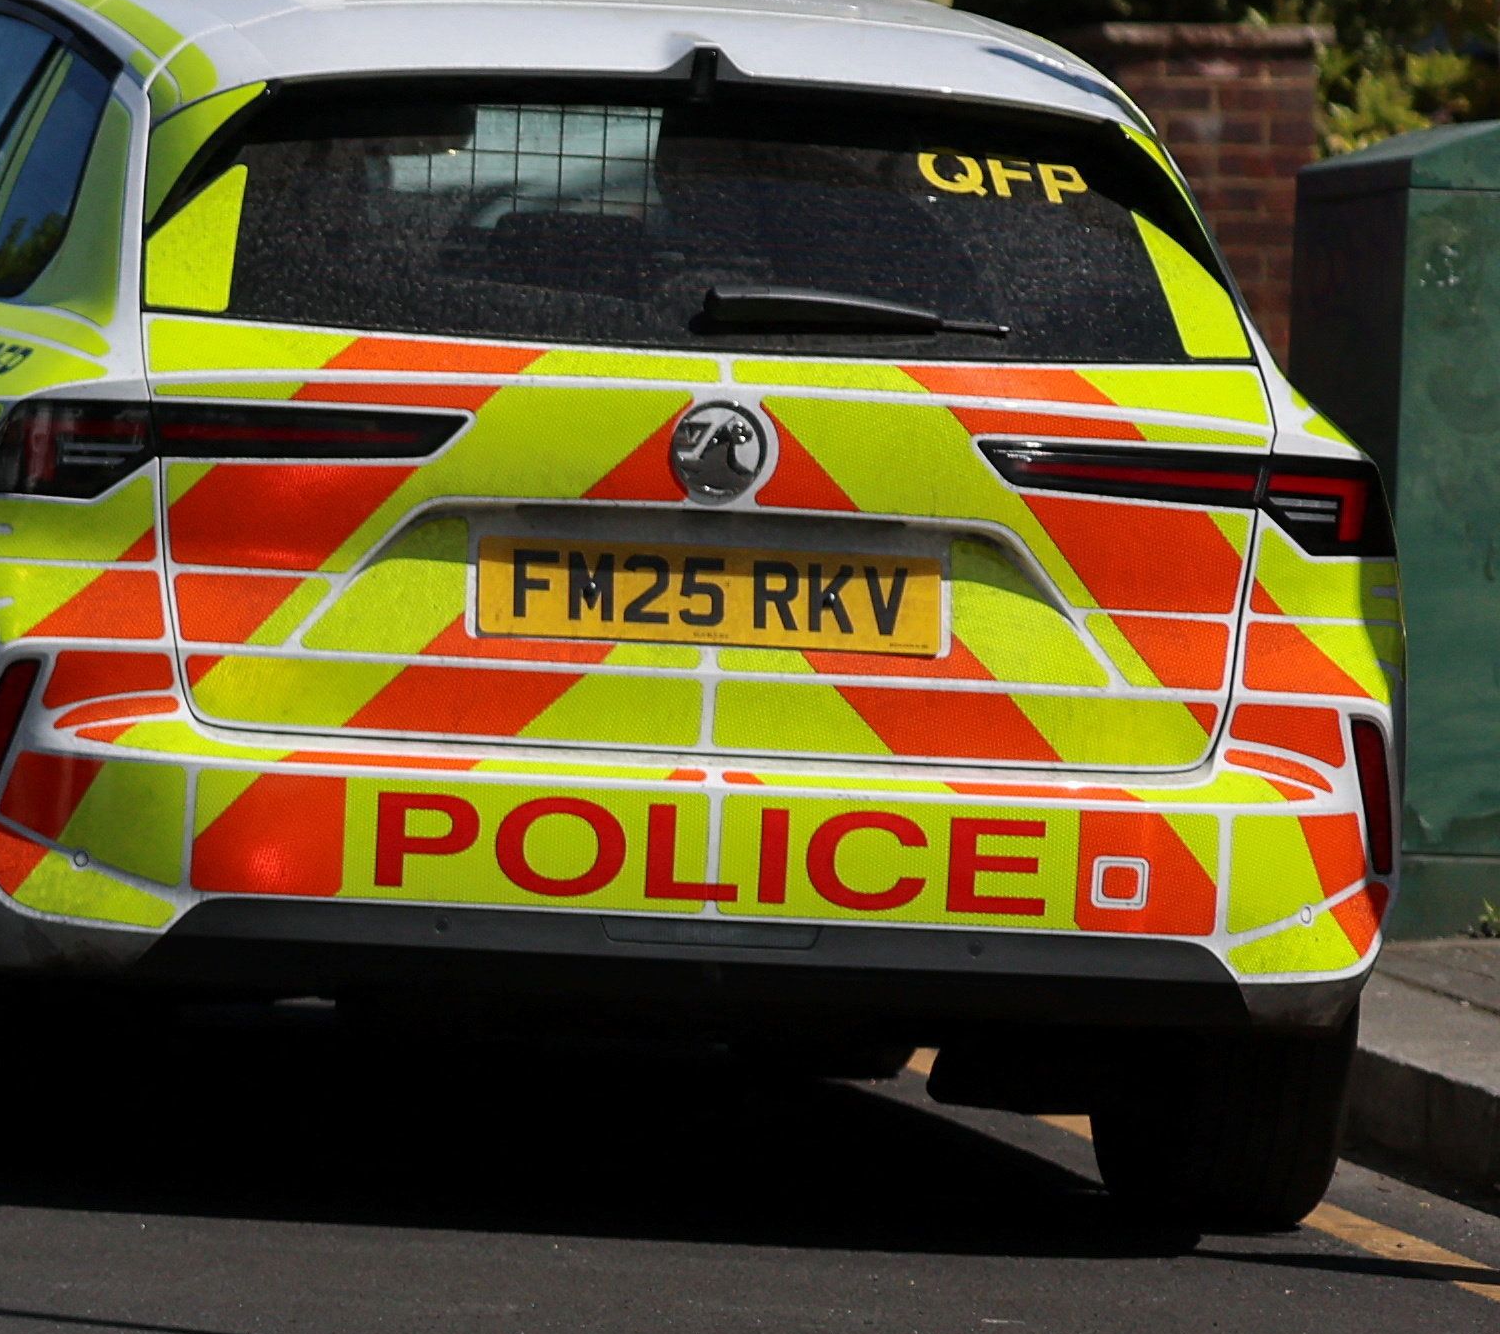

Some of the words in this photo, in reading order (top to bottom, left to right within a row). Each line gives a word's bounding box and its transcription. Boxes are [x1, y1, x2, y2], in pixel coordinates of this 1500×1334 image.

[918, 149, 1088, 204] QFP
[512, 547, 726, 628] FM25
[752, 559, 909, 637] RKV
[373, 791, 1048, 918] POLICE
